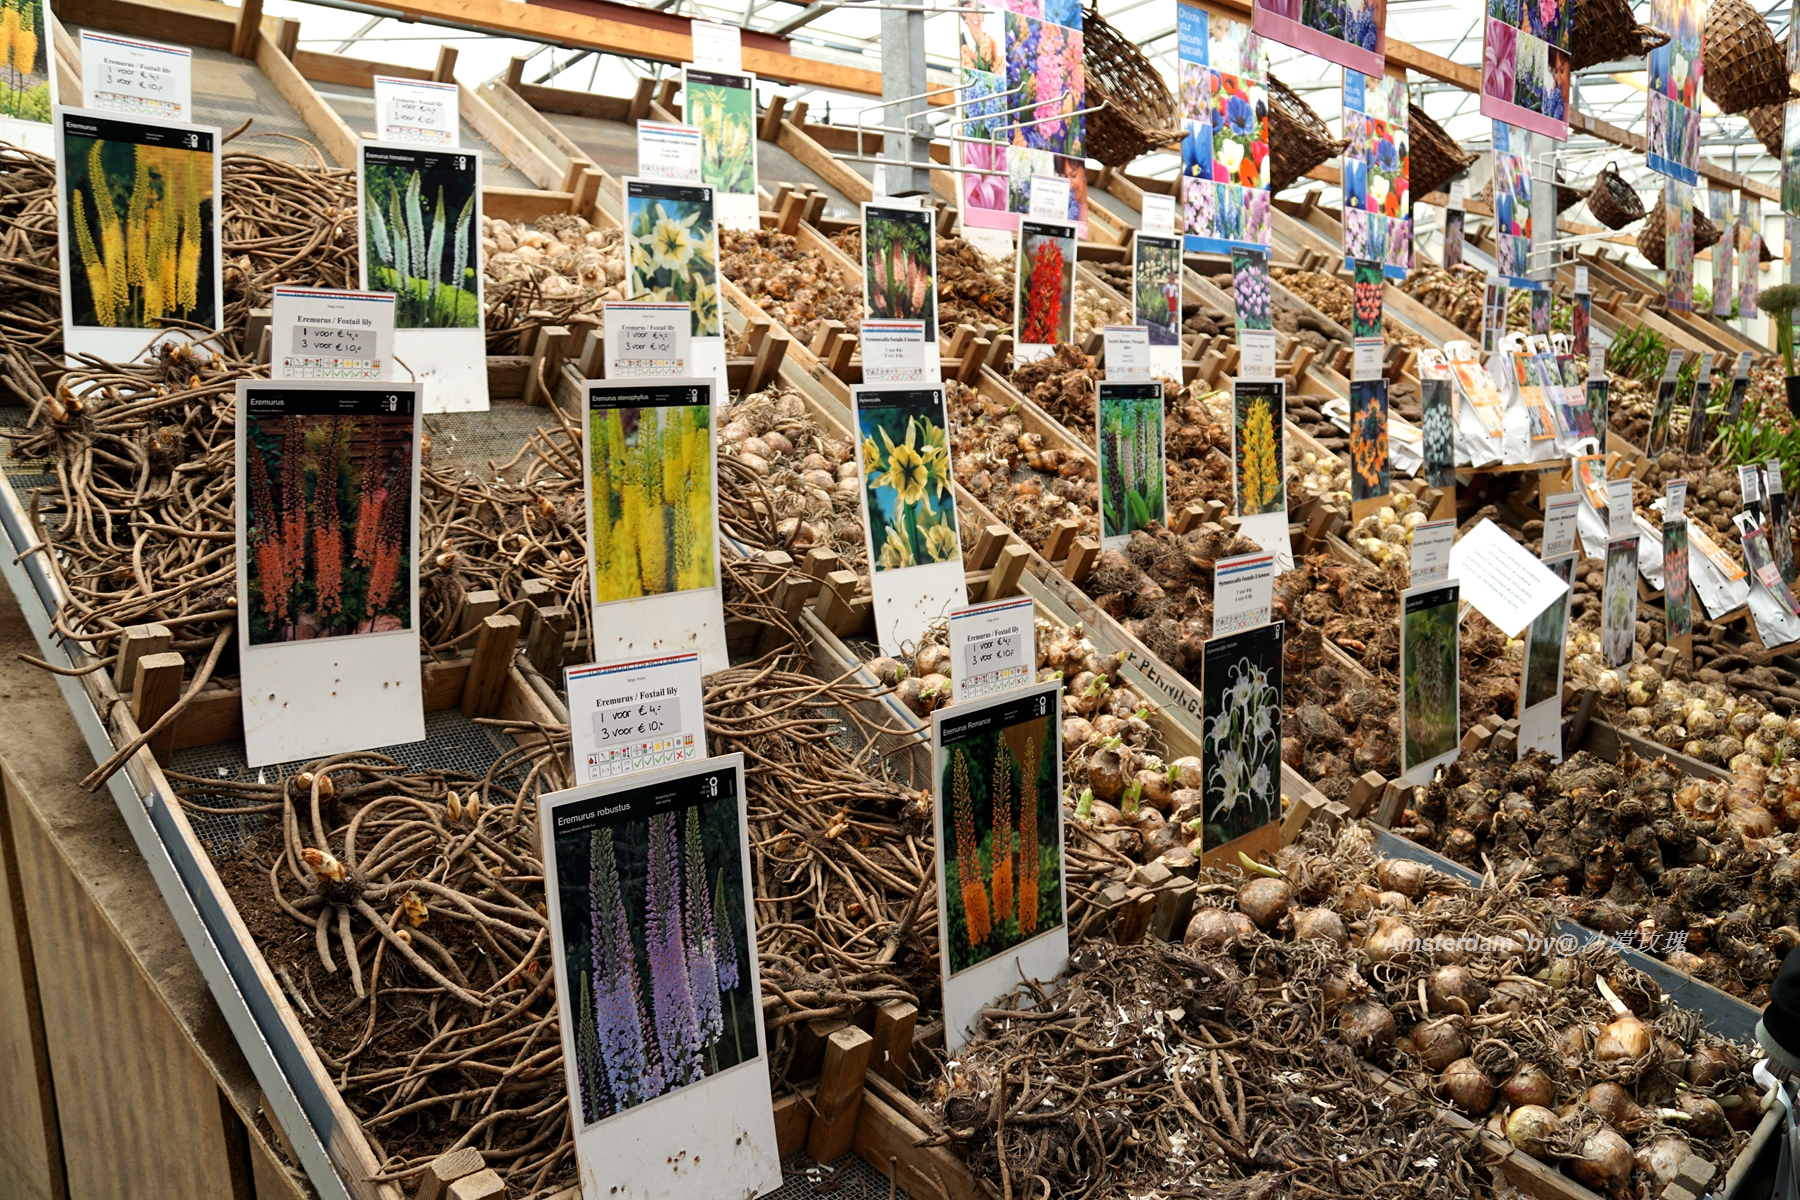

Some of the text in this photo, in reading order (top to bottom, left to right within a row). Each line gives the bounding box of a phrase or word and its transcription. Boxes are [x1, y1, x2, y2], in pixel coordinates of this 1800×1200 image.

[104, 58, 134, 68] Eremurus
[106, 74, 112, 84] 3
[394, 112, 399, 120] 3
[66, 121, 98, 132] Eremurus
[366, 152, 388, 160] Eremurus
[297, 316, 332, 324] Eremurus
[337, 316, 360, 326] Foxtail
[362, 318, 372, 327] lily
[304, 328, 307, 336] 1
[302, 340, 308, 348] 3
[626, 342, 631, 350] 3
[617, 394, 649, 402] stenophyllus
[1218, 577, 1241, 587] Hymenocallis
[967, 632, 991, 642] Eremurus
[994, 627, 1012, 637] Foxtail
[974, 644, 976, 652] 1
[980, 641, 994, 650] voor
[972, 656, 978, 665] 3
[980, 654, 993, 662] voor
[588, 656, 680, 676] TOP PRODUCT OF HOLLAND
[596, 696, 633, 707] Eremurus
[640, 688, 665, 700] Foxtail
[666, 687, 678, 697] lily
[601, 713, 604, 722] 1
[612, 710, 631, 720] voor
[943, 718, 991, 736] Eremurus Romance
[601, 728, 610, 740] 3
[612, 726, 633, 737] voor
[558, 802, 631, 826] Eremurus robustus
